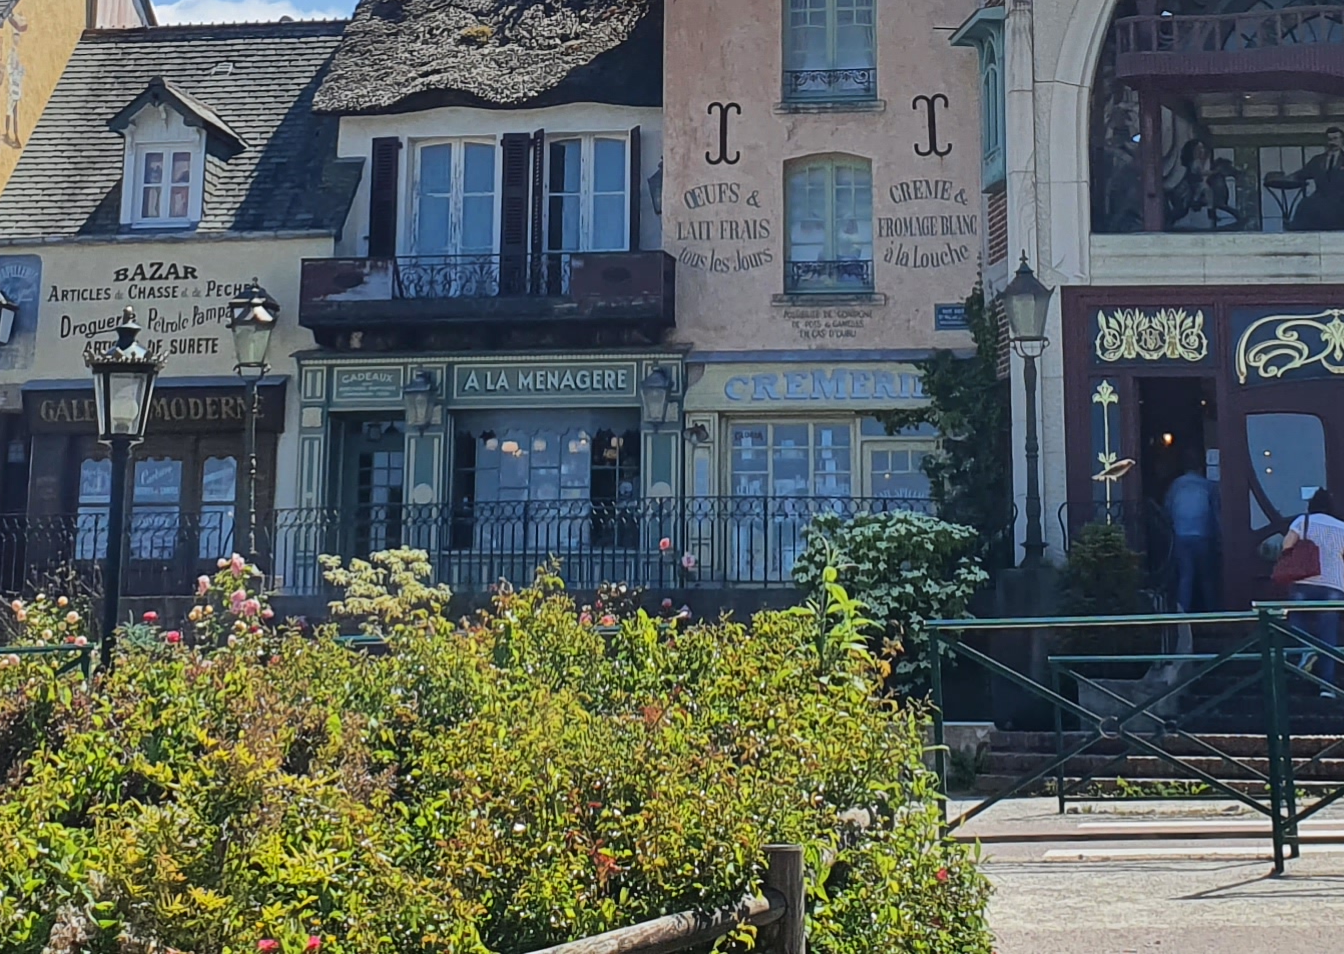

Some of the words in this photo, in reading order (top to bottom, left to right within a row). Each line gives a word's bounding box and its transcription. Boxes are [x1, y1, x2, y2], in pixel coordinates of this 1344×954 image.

[746, 190, 761, 208] &
[954, 188, 969, 206] &
[677, 221, 714, 240] LAIT
[720, 219, 770, 240] FRAIS
[877, 217, 938, 237] FROMAGE
[939, 214, 977, 236] BLANC
[710, 249, 730, 273] les
[895, 243, 910, 267] la
[113, 262, 198, 282] BAZAR
[48, 285, 111, 302] ARTICLES
[128, 284, 179, 299] CHASSE
[170, 338, 218, 354] SURETE
[341, 372, 393, 383] CADEAUX
[465, 371, 479, 390] A
[486, 370, 509, 390] LA
[518, 368, 628, 390] MENAGERE
